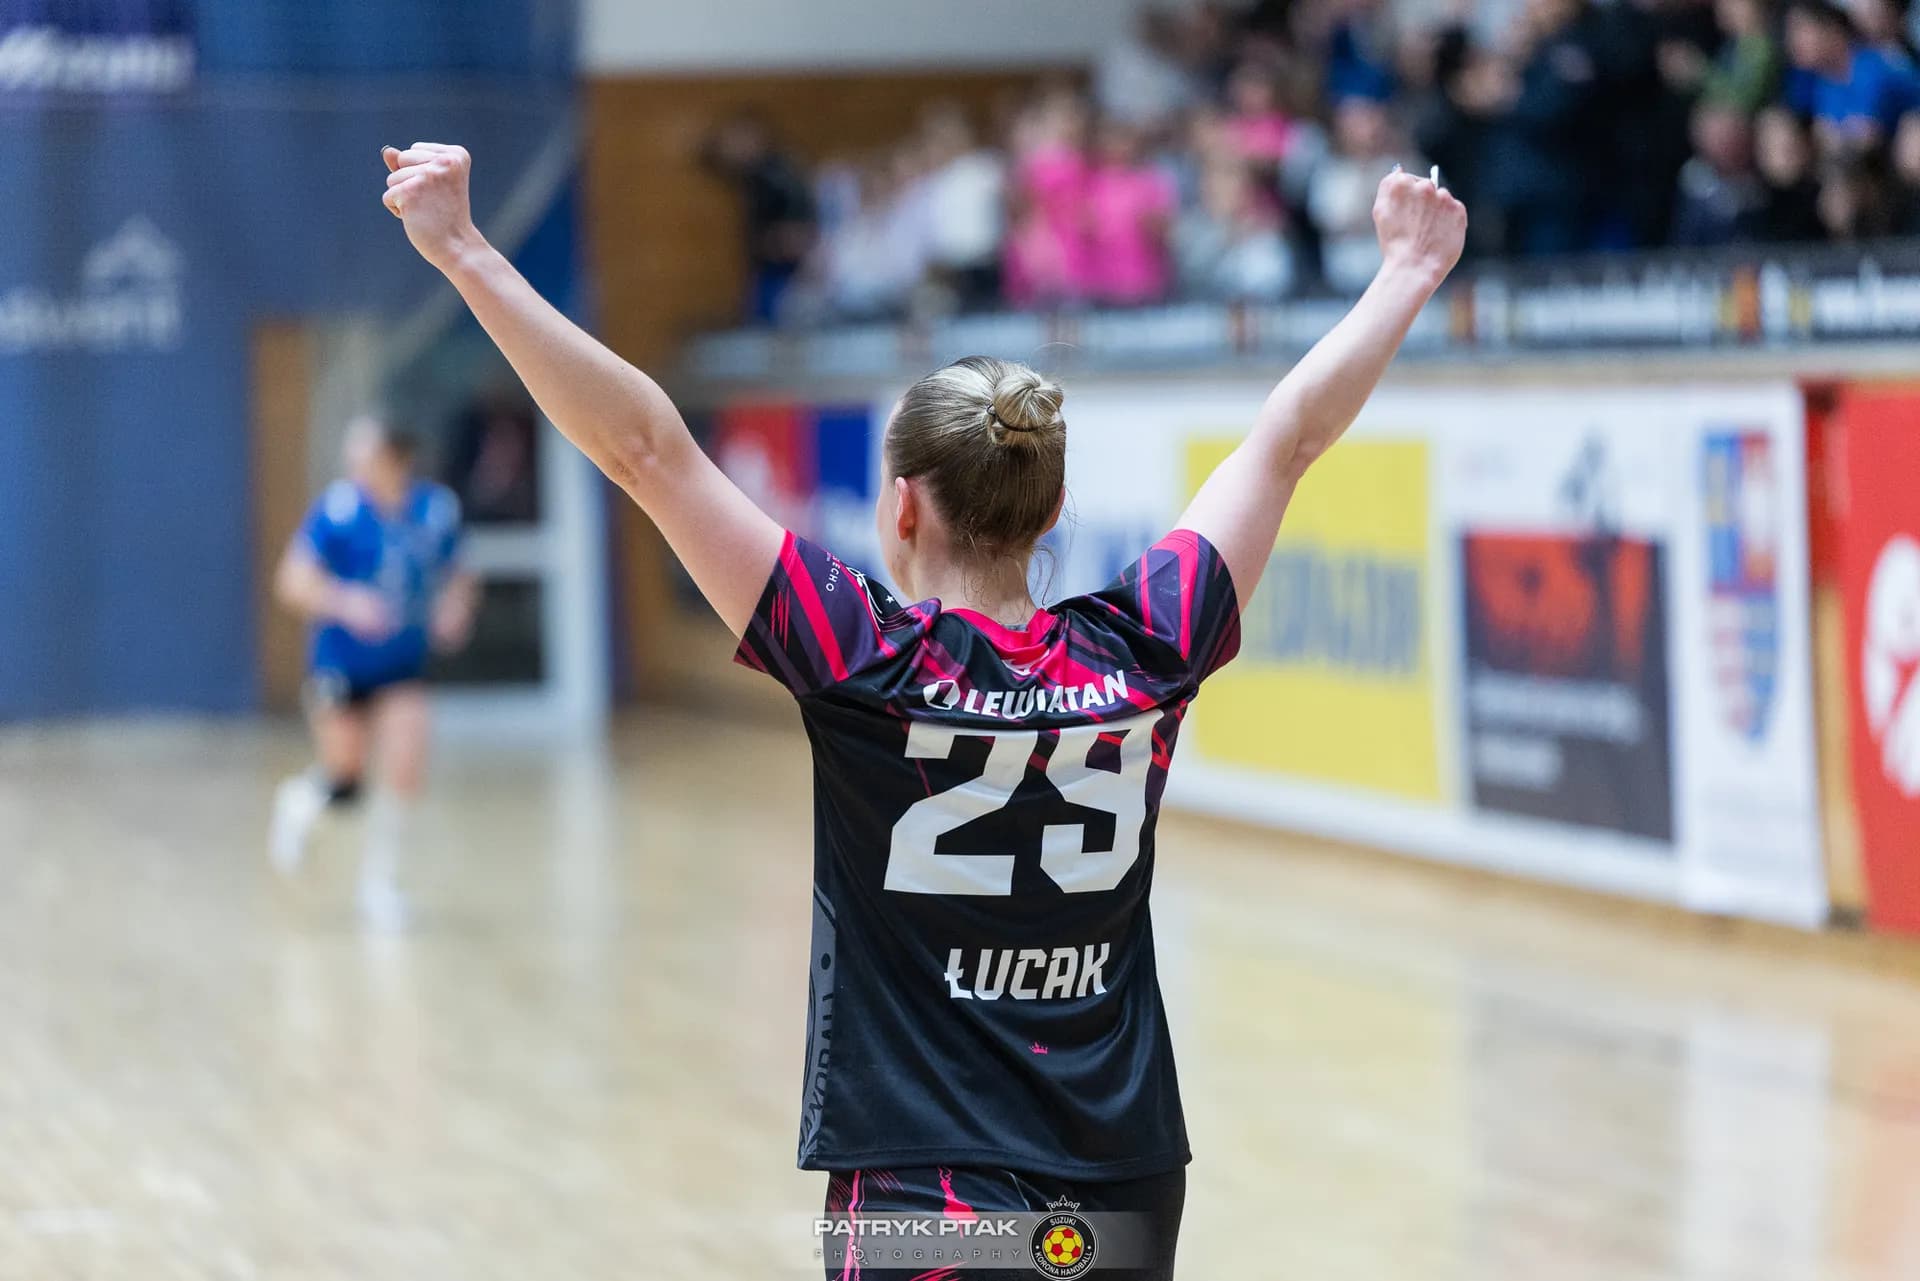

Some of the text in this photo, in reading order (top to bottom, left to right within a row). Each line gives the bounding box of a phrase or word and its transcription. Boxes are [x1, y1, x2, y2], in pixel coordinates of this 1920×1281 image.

[963, 669, 1129, 720] LEWIATAN
[884, 709, 1165, 896] 29
[944, 942, 1111, 1000] ŁUCAK
